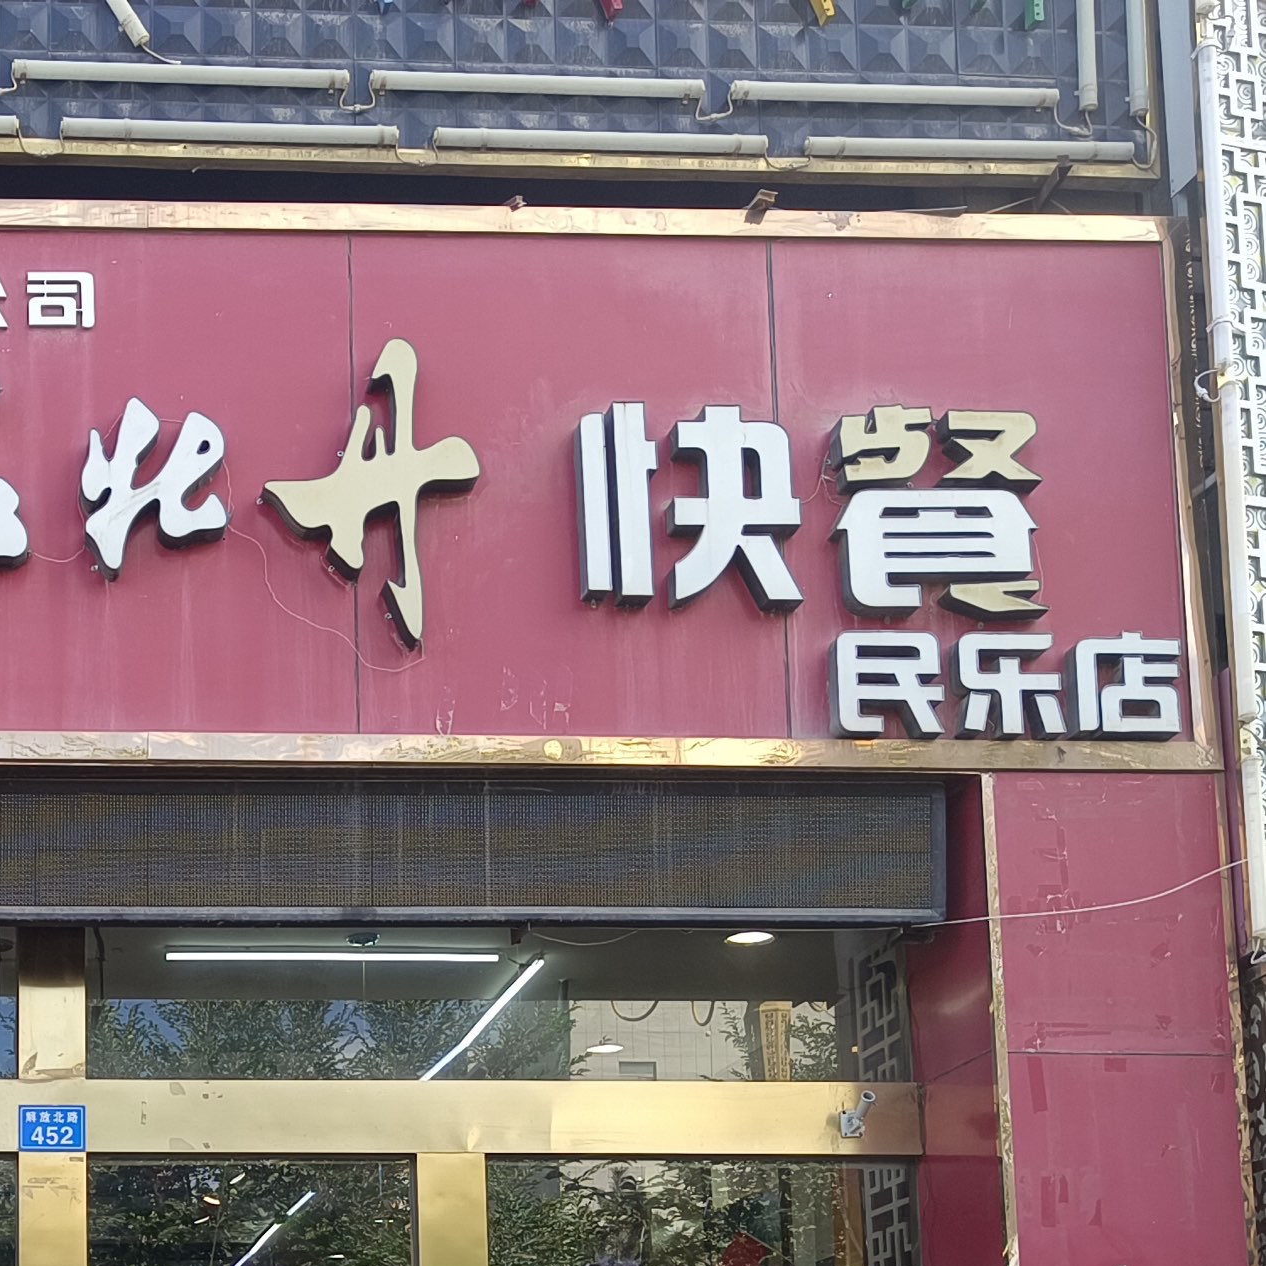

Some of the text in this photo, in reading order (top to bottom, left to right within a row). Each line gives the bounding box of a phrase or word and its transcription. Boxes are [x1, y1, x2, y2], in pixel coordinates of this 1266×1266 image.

[831, 629, 1183, 741] 民乐店
[30, 1126, 75, 1145] 452
